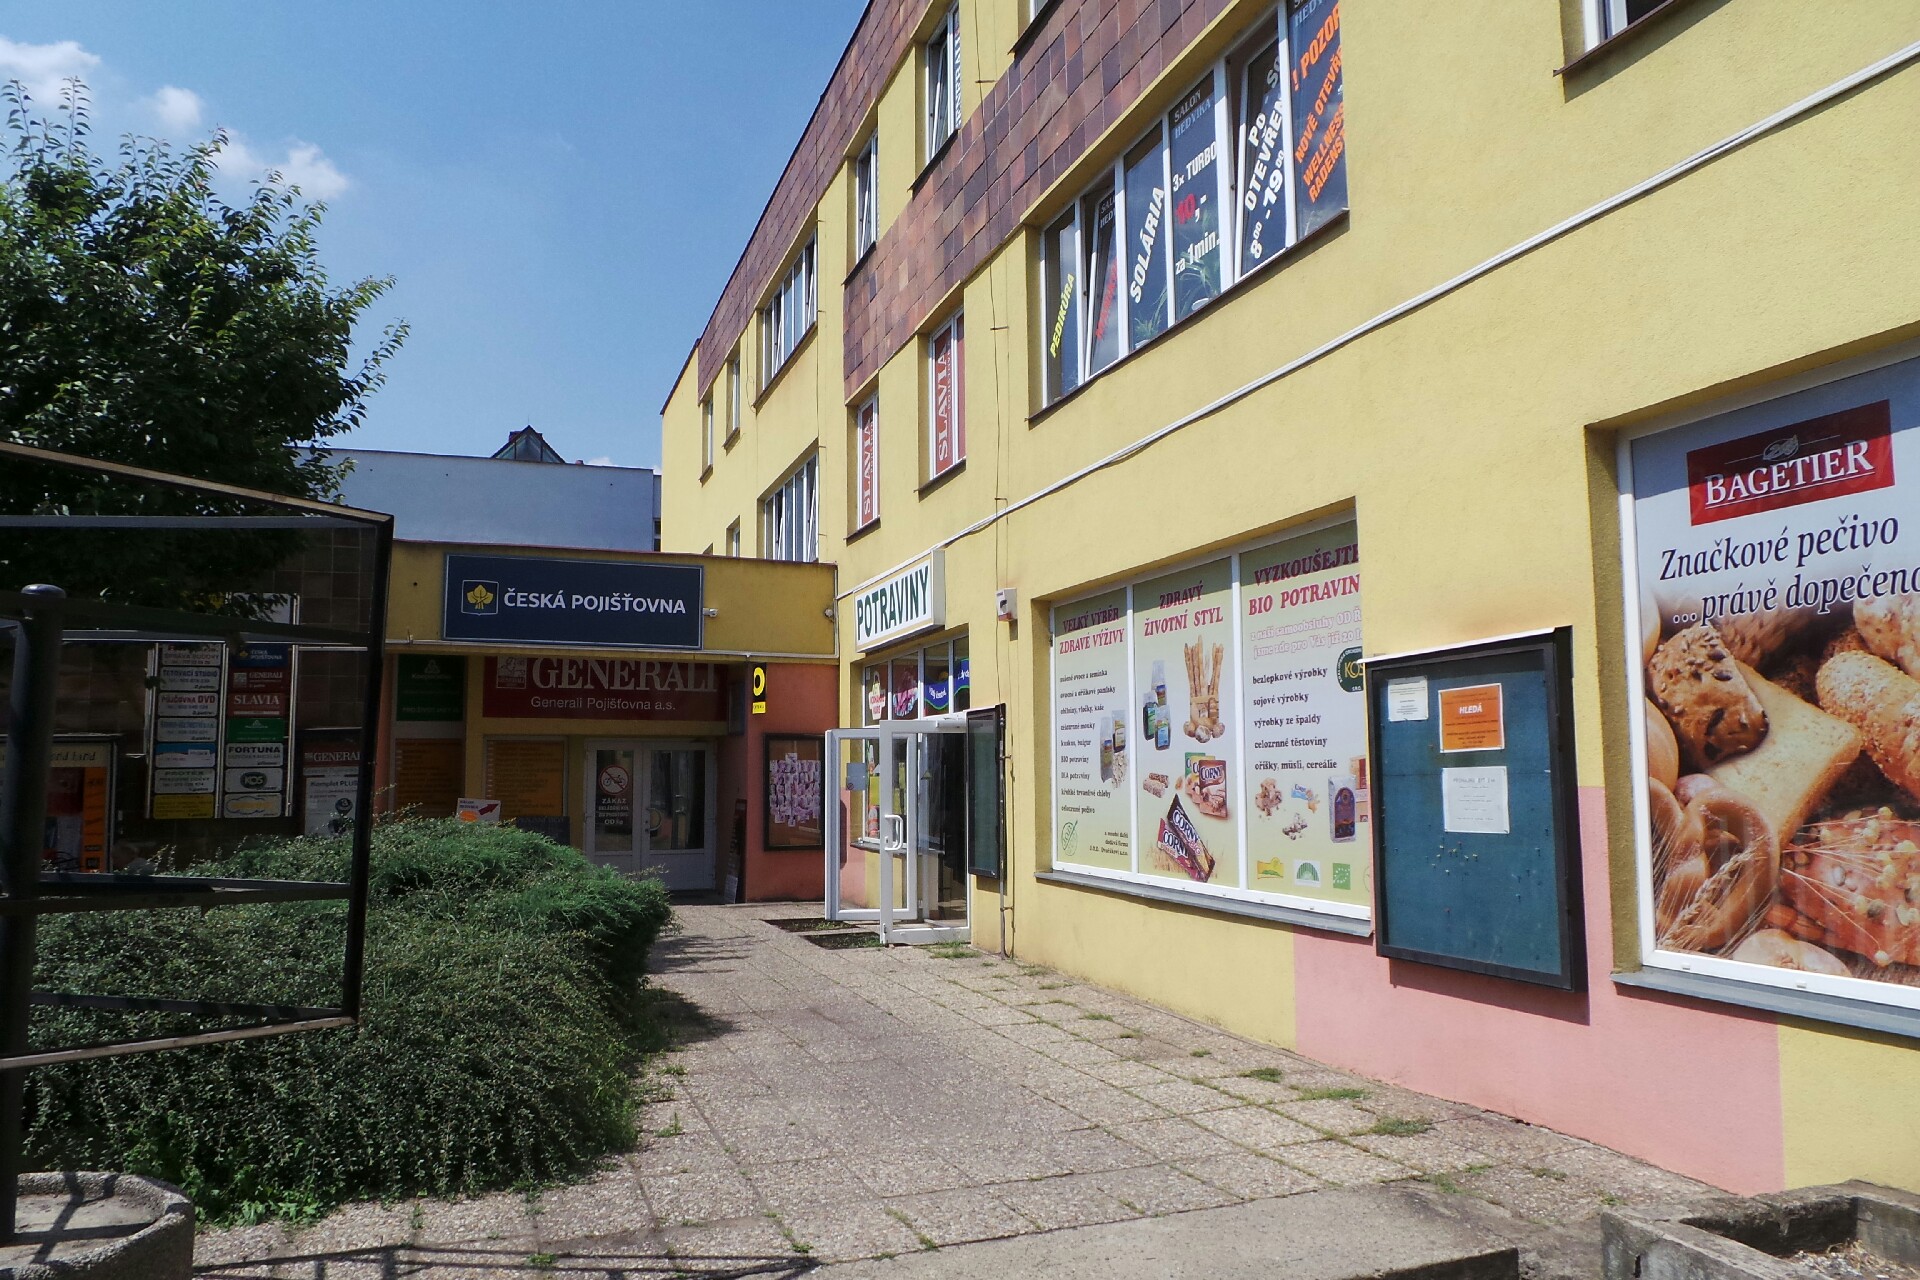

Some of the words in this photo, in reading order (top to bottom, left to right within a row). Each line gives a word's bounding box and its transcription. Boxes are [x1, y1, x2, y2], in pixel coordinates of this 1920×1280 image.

[1174, 89, 1201, 123] SALON
[1175, 98, 1211, 139] HEDVIKA
[1248, 113, 1267, 147] PO
[1295, 112, 1319, 164] NOVĚ
[1173, 173, 1185, 192] 3x
[1186, 141, 1218, 182] TURBO
[1130, 187, 1165, 304] SOLÁRIA
[1175, 257, 1186, 276] za
[938, 344, 948, 461] SLAVIA
[1704, 439, 1875, 506] BAGETIER
[1660, 526, 1790, 581] Značkové
[1796, 514, 1900, 569] pečivo
[504, 588, 566, 609] ČESKÁ
[571, 592, 686, 614] POJIŠŤOVNA
[857, 565, 929, 641] POTRAVINY
[1159, 580, 1204, 609] ZDRAVÝ
[1249, 595, 1273, 616] BIO
[1062, 611, 1090, 633] VELKÝ
[1091, 605, 1120, 626] VÝBĚR
[1144, 609, 1188, 637] ŽIVOTNÍ
[1193, 606, 1223, 627] STYL
[1273, 616, 1335, 636] samoobsluhy
[1336, 610, 1351, 626] OD
[1059, 632, 1090, 655] ZDRAVÉ
[1092, 628, 1125, 648] VÝŽIVY
[1290, 638, 1308, 653] pro
[1340, 631, 1354, 642] 20
[532, 655, 719, 692] GENERALI
[1252, 670, 1293, 685] bezlepkové
[1294, 667, 1328, 681] výrobky
[197, 695, 216, 704] DVD
[234, 694, 280, 705] SLAVIA
[531, 696, 582, 710] Generali
[587, 697, 651, 712] Pojišťovna
[655, 701, 676, 711] a.s.
[1253, 694, 1276, 708] sojové
[1276, 692, 1310, 706] výrobky
[1459, 703, 1483, 715] HLEDÁ
[1254, 717, 1284, 729] výrobky
[1295, 713, 1322, 726] špaldy
[1254, 737, 1289, 749] celozrnné
[1290, 736, 1328, 748] těstoviny
[1200, 765, 1223, 781] CORNY
[1306, 758, 1338, 769] cereálie
[245, 775, 264, 785] KOS
[1172, 810, 1200, 843] CORNY
